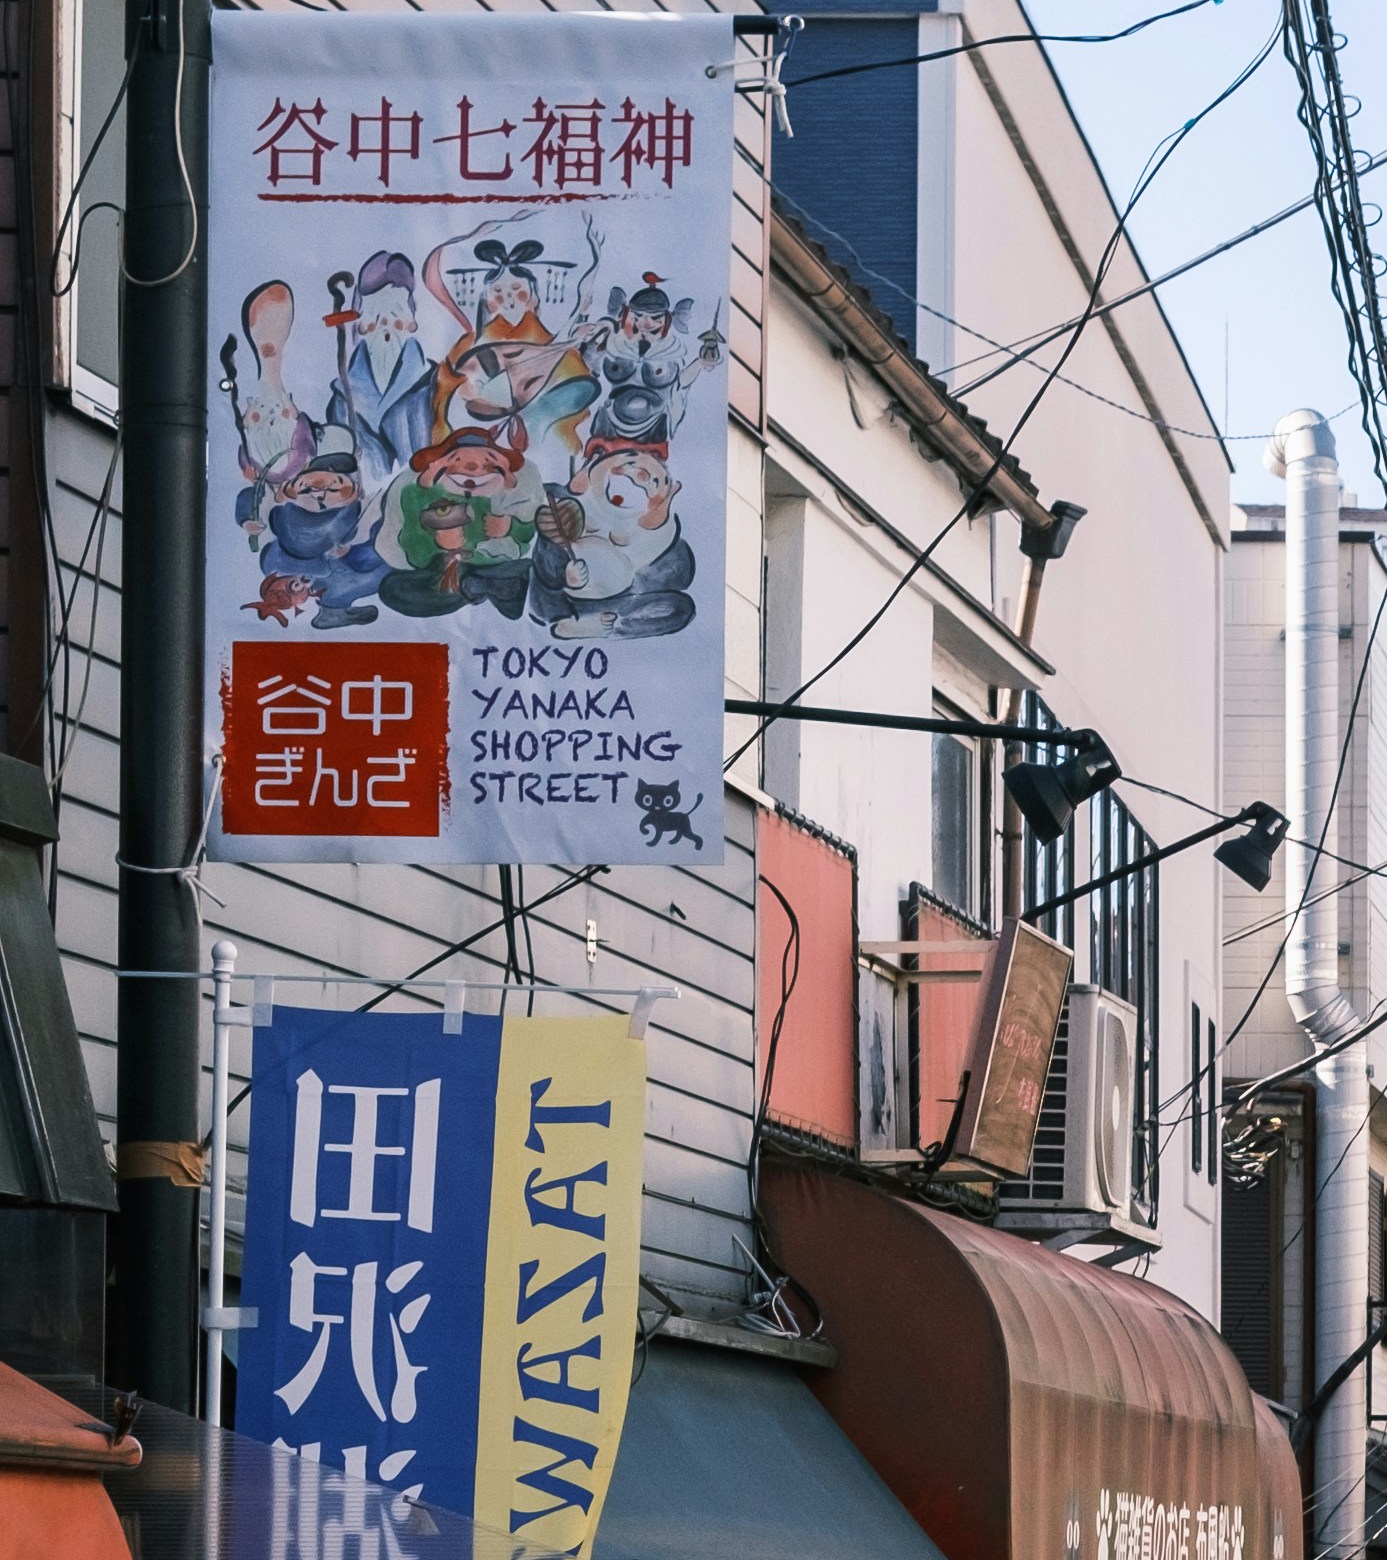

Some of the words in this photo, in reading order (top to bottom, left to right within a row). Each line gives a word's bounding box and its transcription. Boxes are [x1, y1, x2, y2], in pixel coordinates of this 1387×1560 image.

[252, 96, 695, 190] 谷中七福神
[473, 646, 608, 680] TOKYO
[256, 674, 412, 736] 谷中
[473, 688, 635, 721] YANAKA
[471, 730, 682, 764] SHOPPING
[255, 748, 418, 808] ぎんざ
[472, 772, 630, 805] STREET
